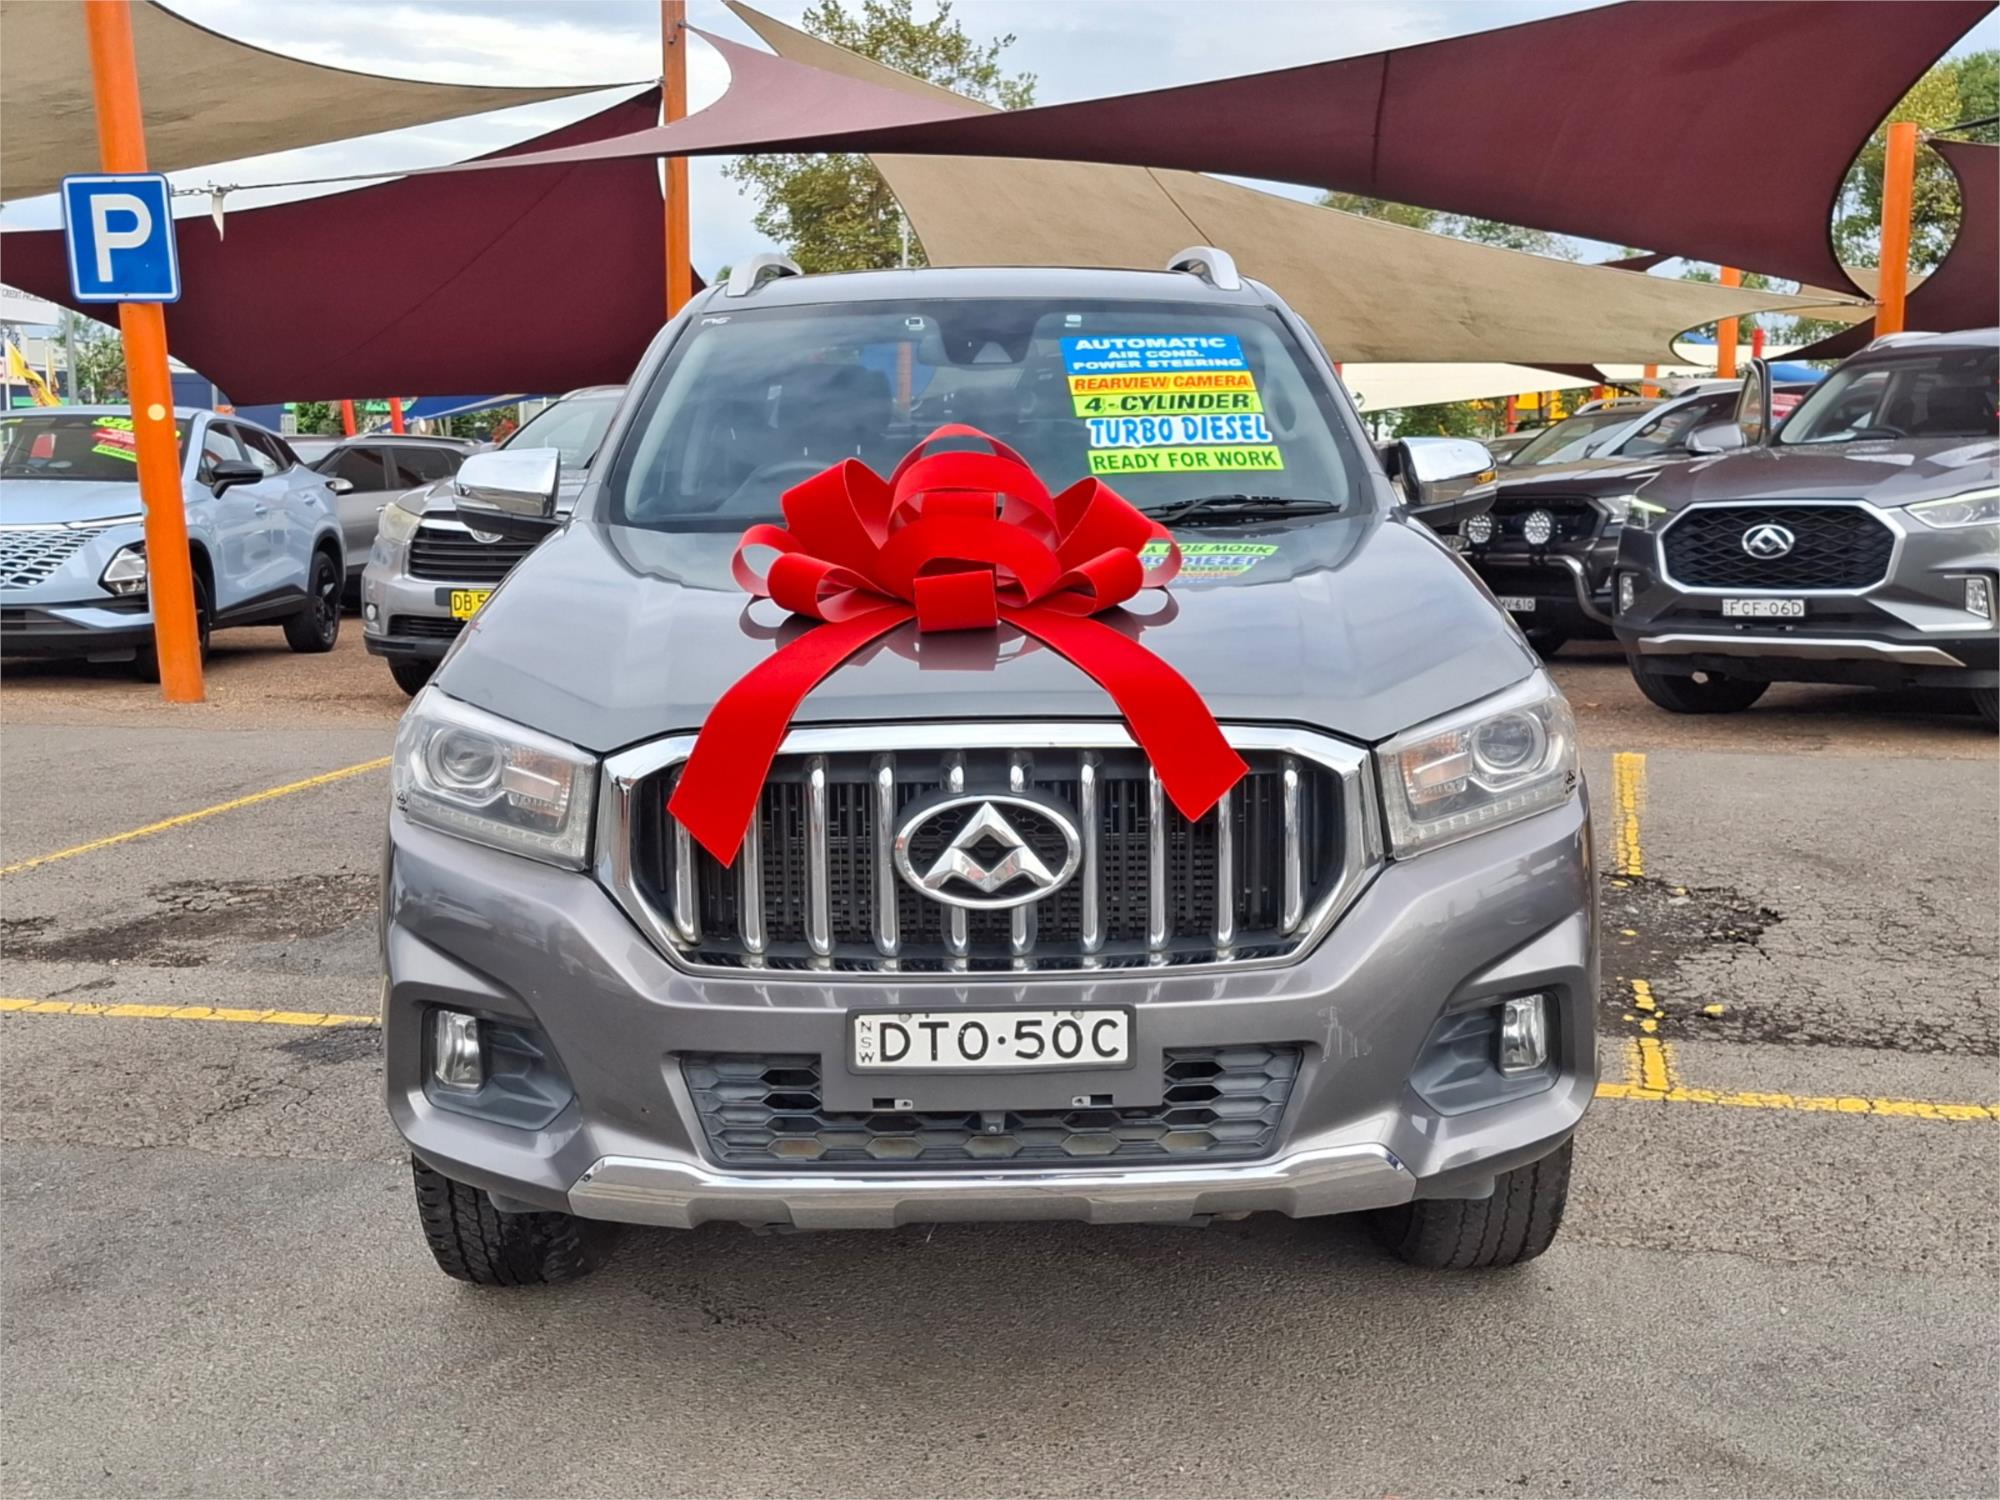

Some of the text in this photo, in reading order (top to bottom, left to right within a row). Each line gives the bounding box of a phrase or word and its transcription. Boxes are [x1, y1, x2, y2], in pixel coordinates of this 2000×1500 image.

[90, 193, 153, 283] P
[1075, 337, 1227, 351] AUTOMATIC
[1107, 349, 1205, 359] AIR COND.
[1072, 358, 1244, 370] POWER STEERING
[1074, 375, 1250, 391] REARVIEW CAMERA
[1090, 414, 1269, 445] TURBO DIESEL
[1092, 450, 1278, 471] READY FOR WORK
